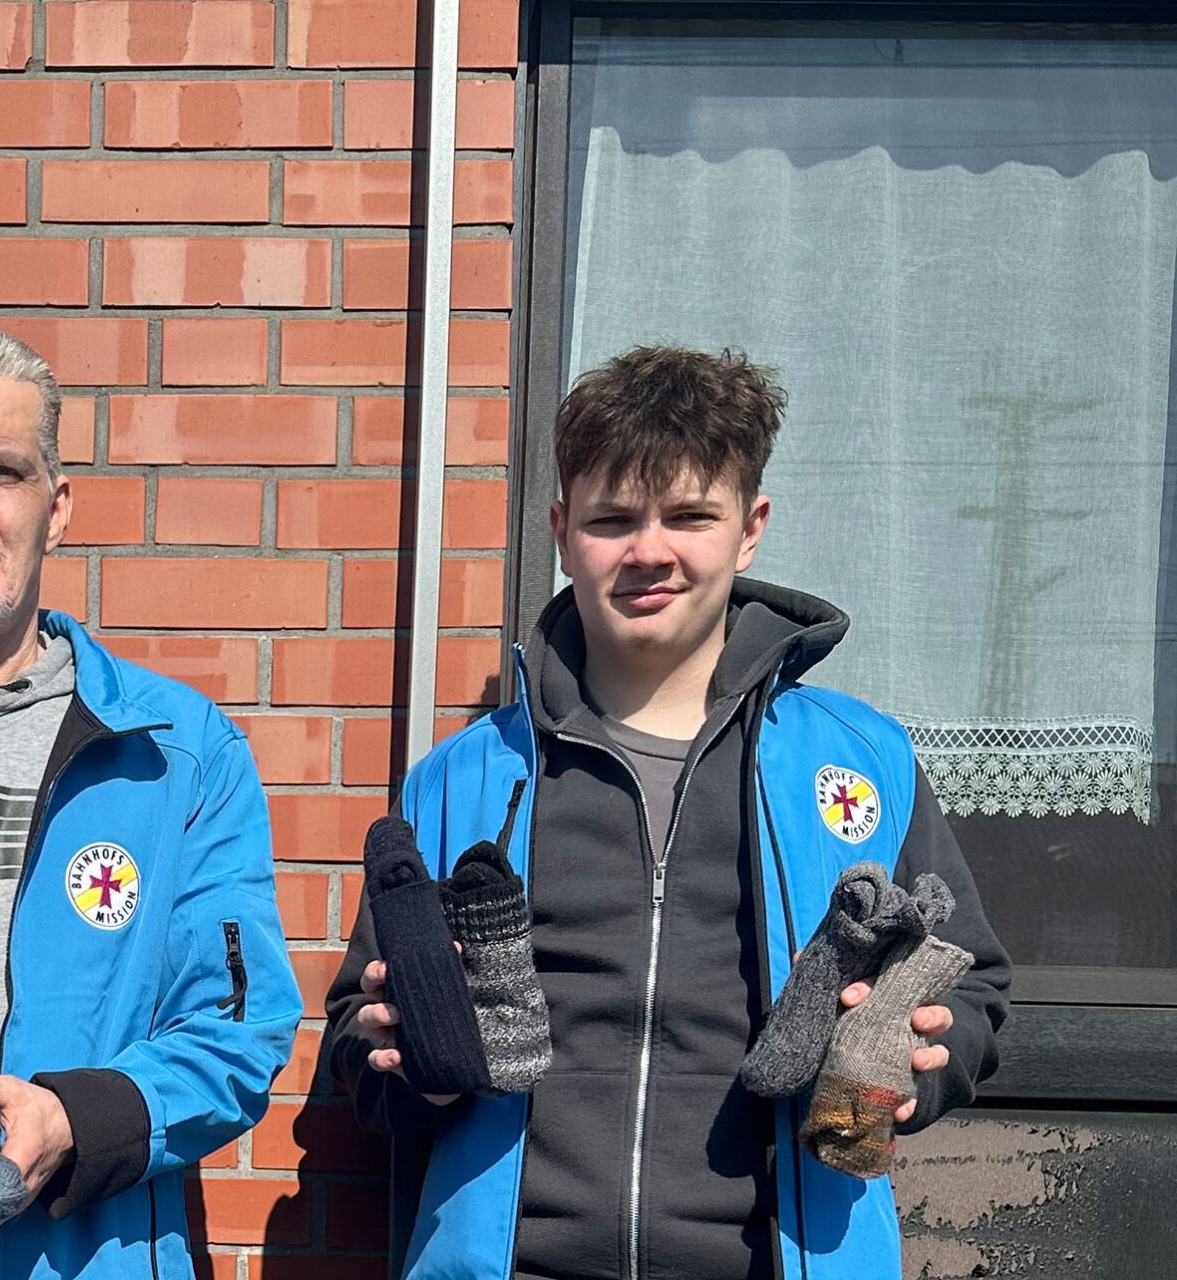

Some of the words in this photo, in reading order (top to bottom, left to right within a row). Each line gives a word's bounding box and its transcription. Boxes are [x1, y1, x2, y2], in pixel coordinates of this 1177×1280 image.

[819, 770, 854, 804] BAHNHOFS
[842, 806, 875, 838] MISSION
[72, 848, 124, 889] BAHNHOFS
[95, 891, 136, 924] MISSION
